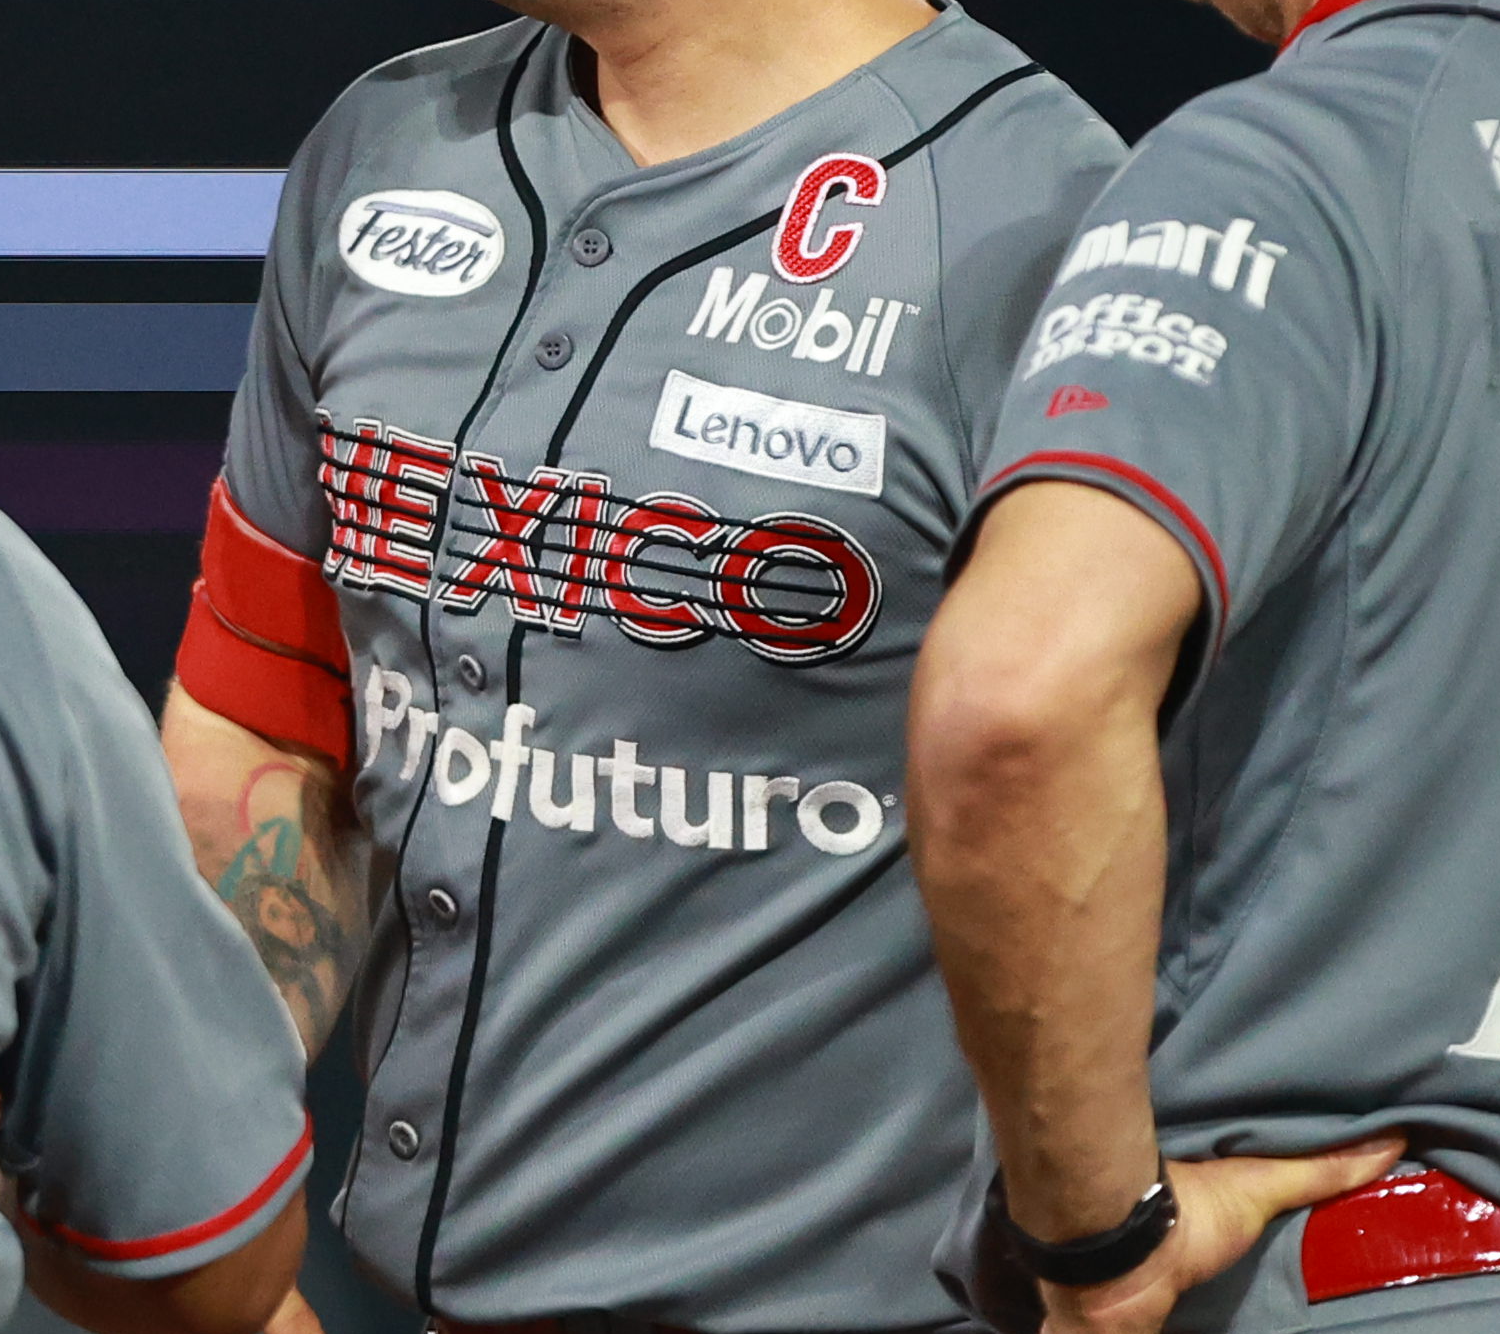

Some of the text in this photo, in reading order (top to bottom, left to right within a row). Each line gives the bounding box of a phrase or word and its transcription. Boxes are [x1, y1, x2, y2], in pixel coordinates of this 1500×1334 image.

[347, 201, 496, 284] Fester
[770, 152, 887, 284] C
[686, 265, 904, 376] Mobil
[673, 395, 862, 473] Lenovo
[361, 665, 886, 855] Profuturo
